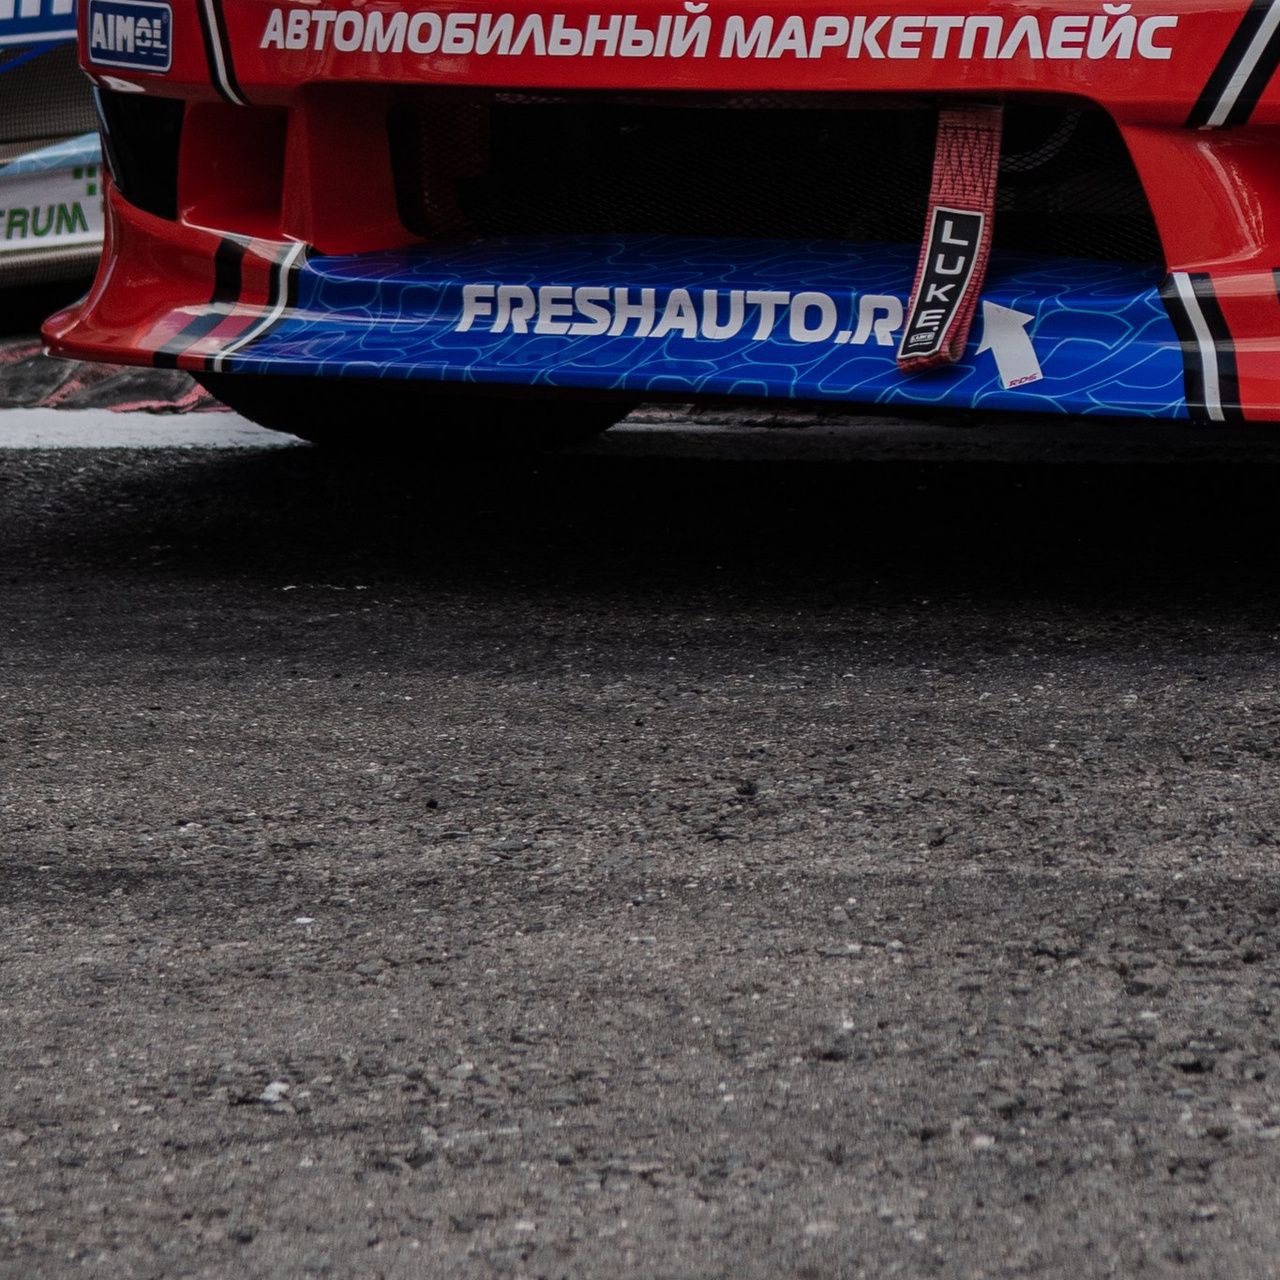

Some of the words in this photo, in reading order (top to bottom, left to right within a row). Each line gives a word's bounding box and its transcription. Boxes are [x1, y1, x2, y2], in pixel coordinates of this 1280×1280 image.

[91, 12, 167, 57] AIMOL
[260, 1, 711, 58] АВТОМОБИЛЬНЫЙ
[719, 3, 1179, 59] МАРКЕТПЛЕЙС
[0, 201, 89, 240] RUM
[454, 284, 912, 346] FRESHAUTO.R
[1009, 372, 1039, 388] RDS
